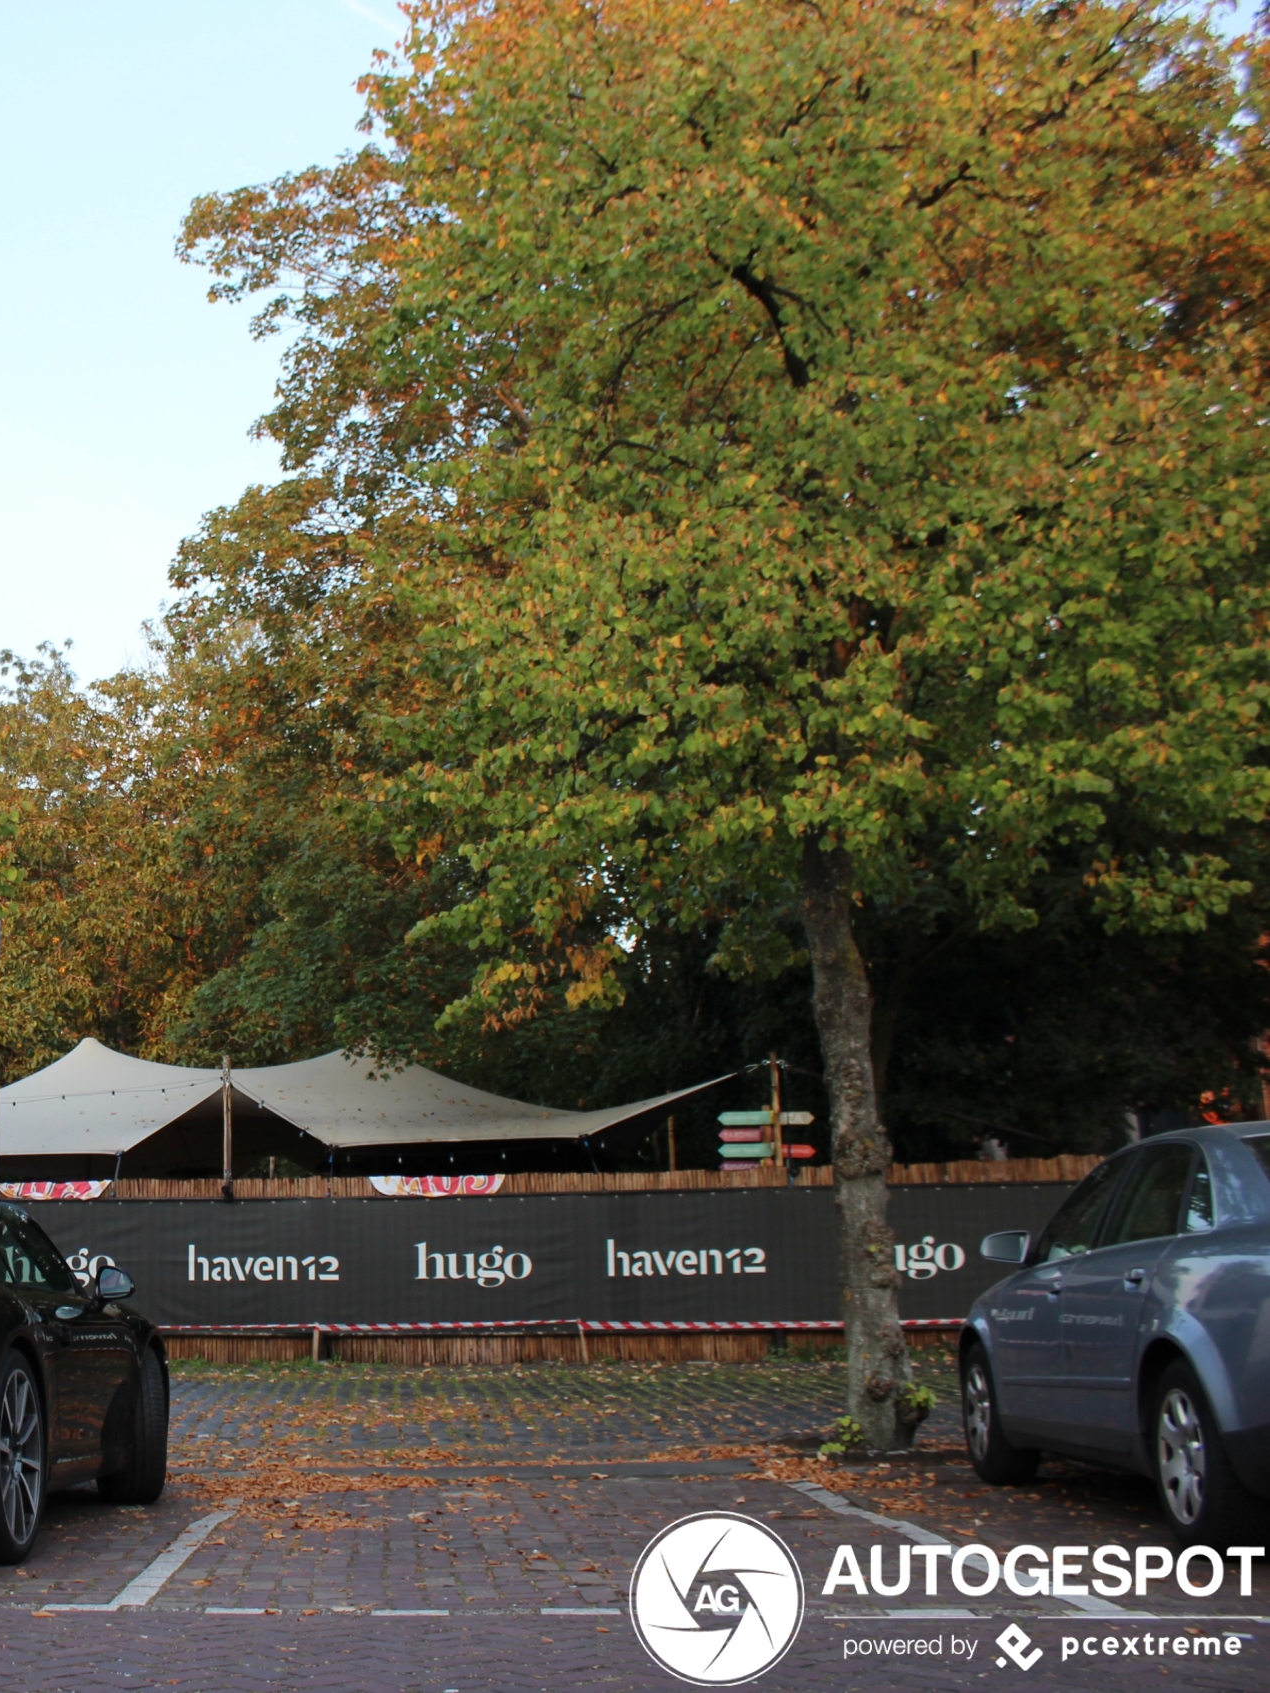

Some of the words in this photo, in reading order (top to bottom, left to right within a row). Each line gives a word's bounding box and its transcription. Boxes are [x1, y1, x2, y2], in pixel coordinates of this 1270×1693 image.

[188, 1244, 340, 1282] haven12
[414, 1241, 532, 1288] hugo
[607, 1239, 766, 1277] haven12
